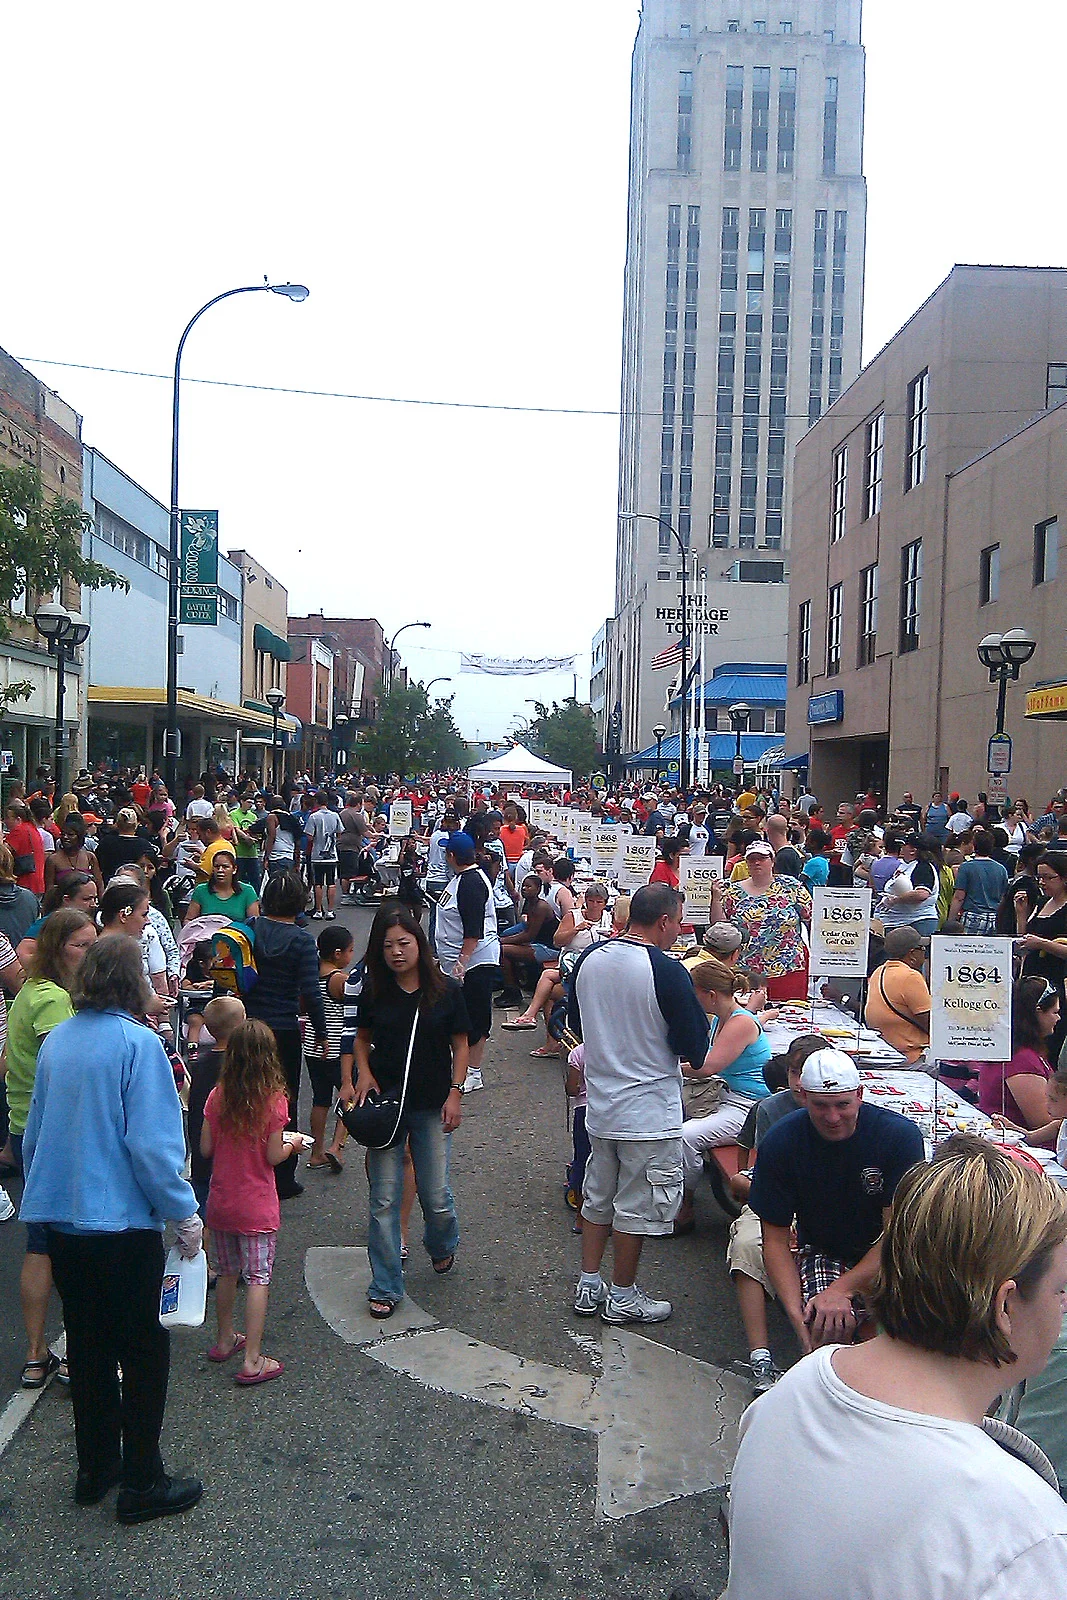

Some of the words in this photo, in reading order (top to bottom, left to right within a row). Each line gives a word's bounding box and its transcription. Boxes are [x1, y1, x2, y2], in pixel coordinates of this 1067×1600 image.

[677, 594, 708, 607] THE
[187, 603, 211, 611] BATTLE
[186, 611, 212, 620] CREEK
[656, 608, 729, 621] HERITAGE
[665, 622, 719, 635] TOWER
[625, 845, 652, 855] 1867
[686, 869, 718, 879] 1866
[822, 907, 863, 921] 1865
[821, 930, 841, 938] Cedar
[825, 938, 840, 946] Golf
[944, 965, 1003, 984] 1864
[943, 998, 981, 1011] Kellogg
[983, 999, 1000, 1010] Co.
